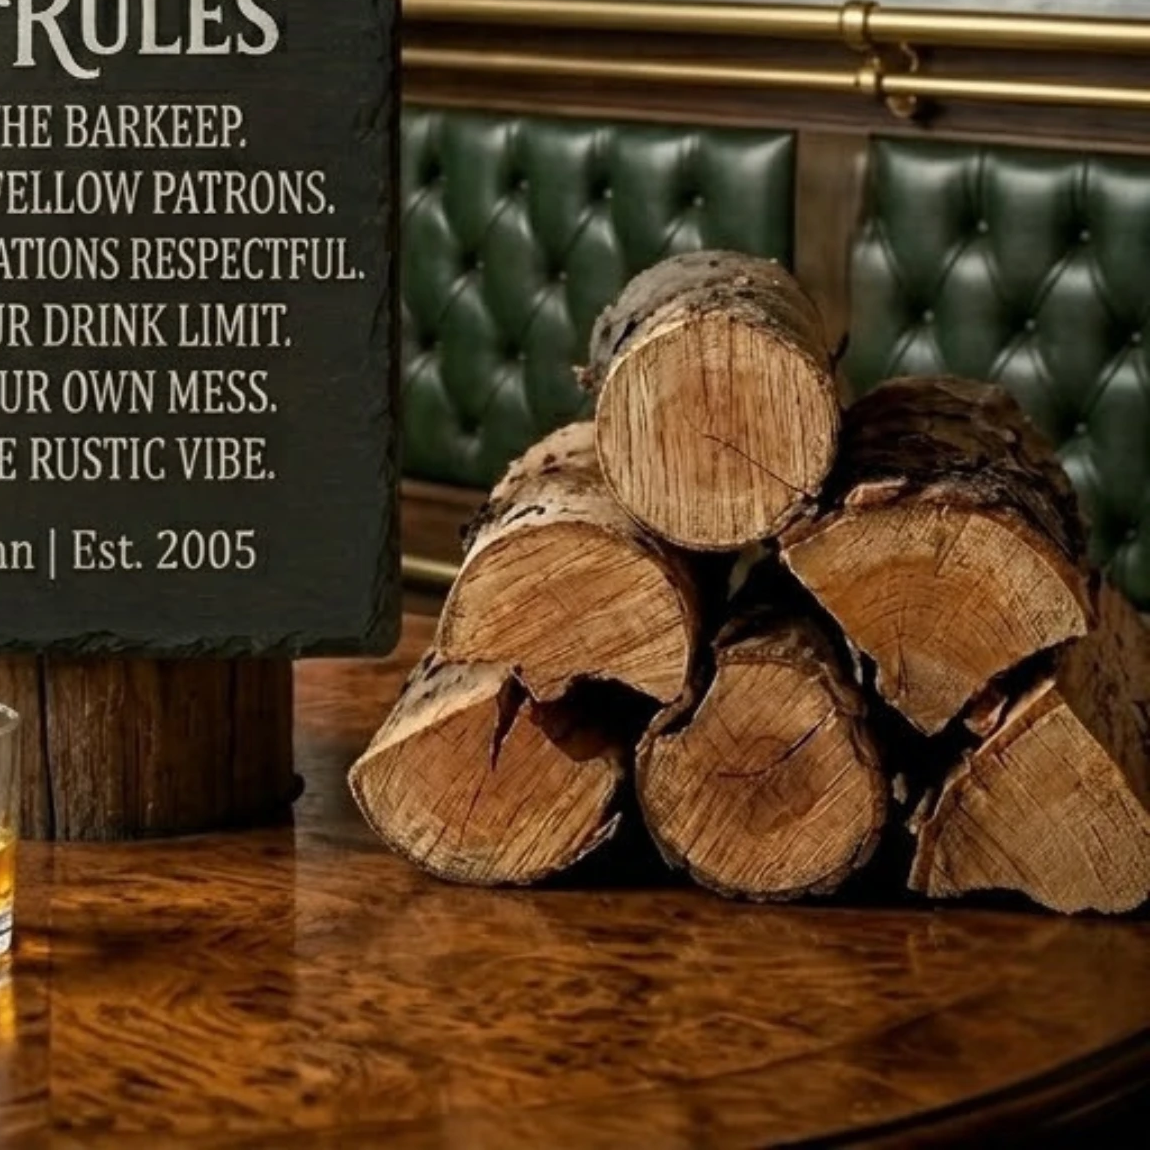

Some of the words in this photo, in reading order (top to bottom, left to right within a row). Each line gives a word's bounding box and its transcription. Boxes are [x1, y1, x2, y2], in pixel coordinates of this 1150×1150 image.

[64, 104, 247, 148] BARKEEP.
[152, 170, 336, 215] PATRONS.
[129, 237, 366, 280] RESPECTFUL.
[43, 303, 168, 347] DRINK
[178, 303, 292, 347] LIMIT.
[62, 369, 157, 414] OWN
[167, 369, 278, 414] MESS.
[30, 436, 166, 481] RUSTIC
[175, 437, 276, 480] VIBE.
[72, 529, 144, 570] Est.
[156, 529, 257, 570] 2005
